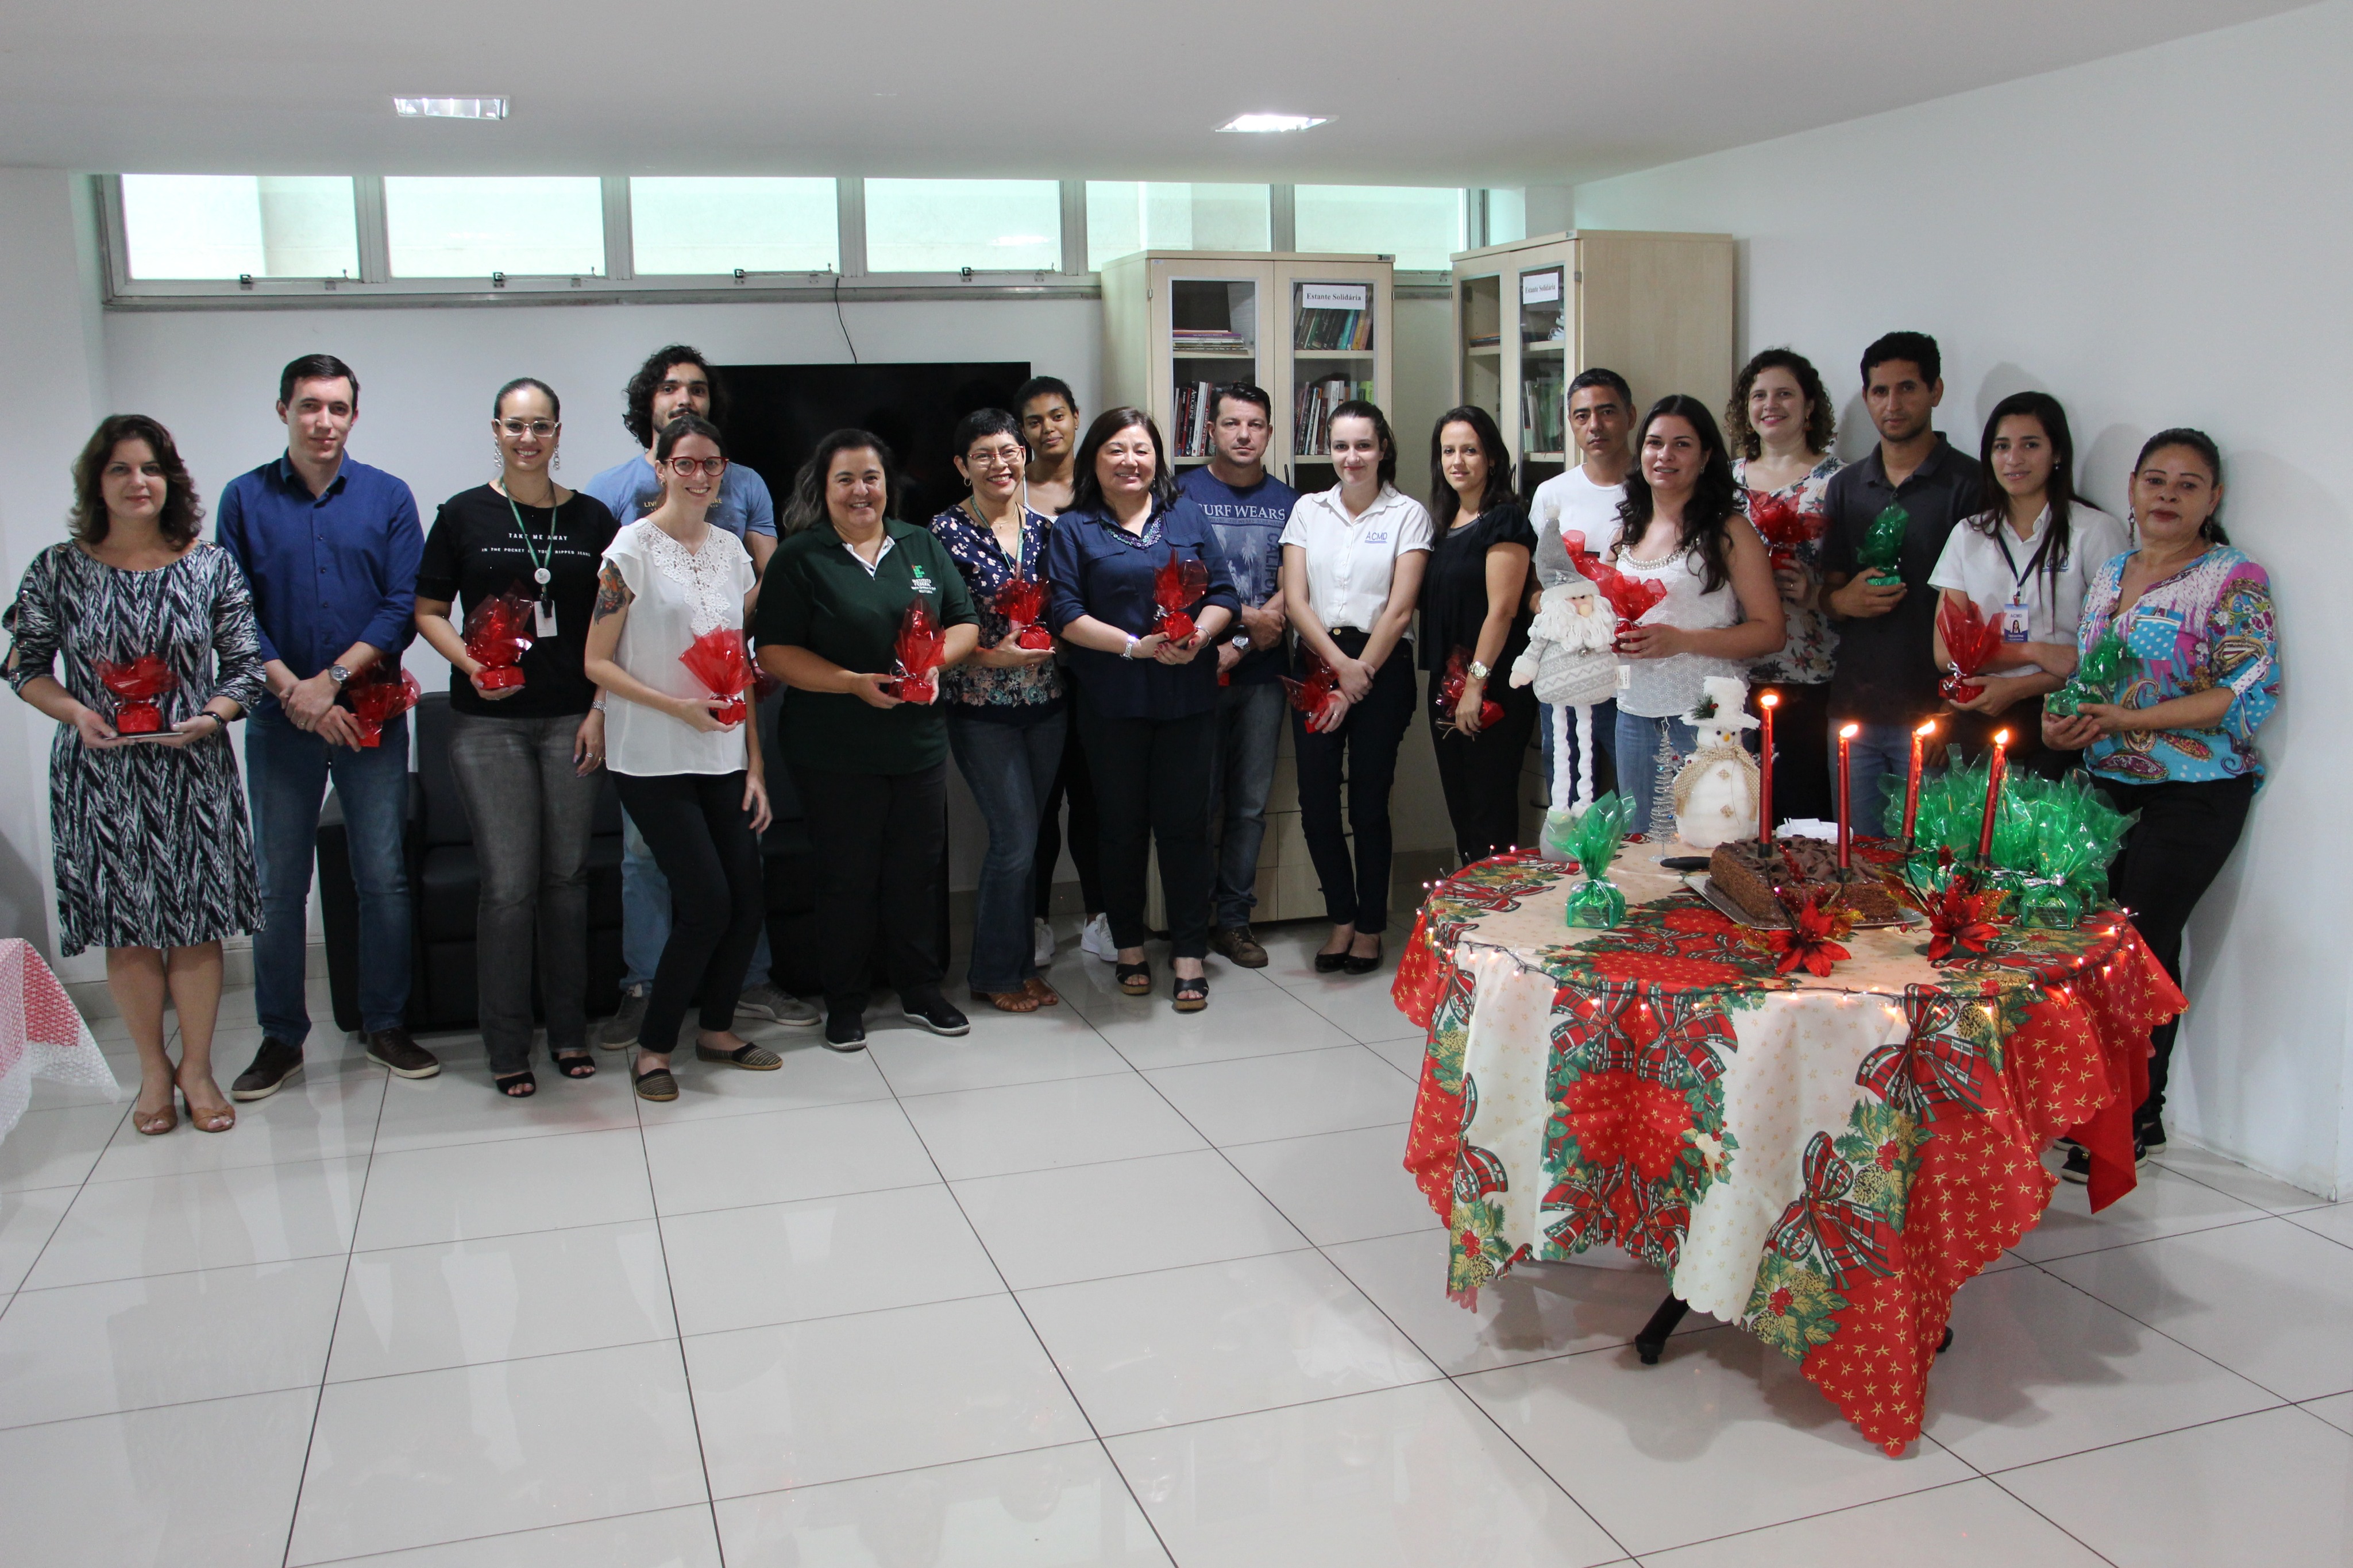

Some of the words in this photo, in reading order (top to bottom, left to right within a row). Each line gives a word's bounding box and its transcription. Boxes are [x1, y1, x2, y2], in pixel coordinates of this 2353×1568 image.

[1235, 505, 1285, 520] WEARS
[1365, 531, 1388, 540] ACMD
[1264, 533, 1279, 593] CALIFO
